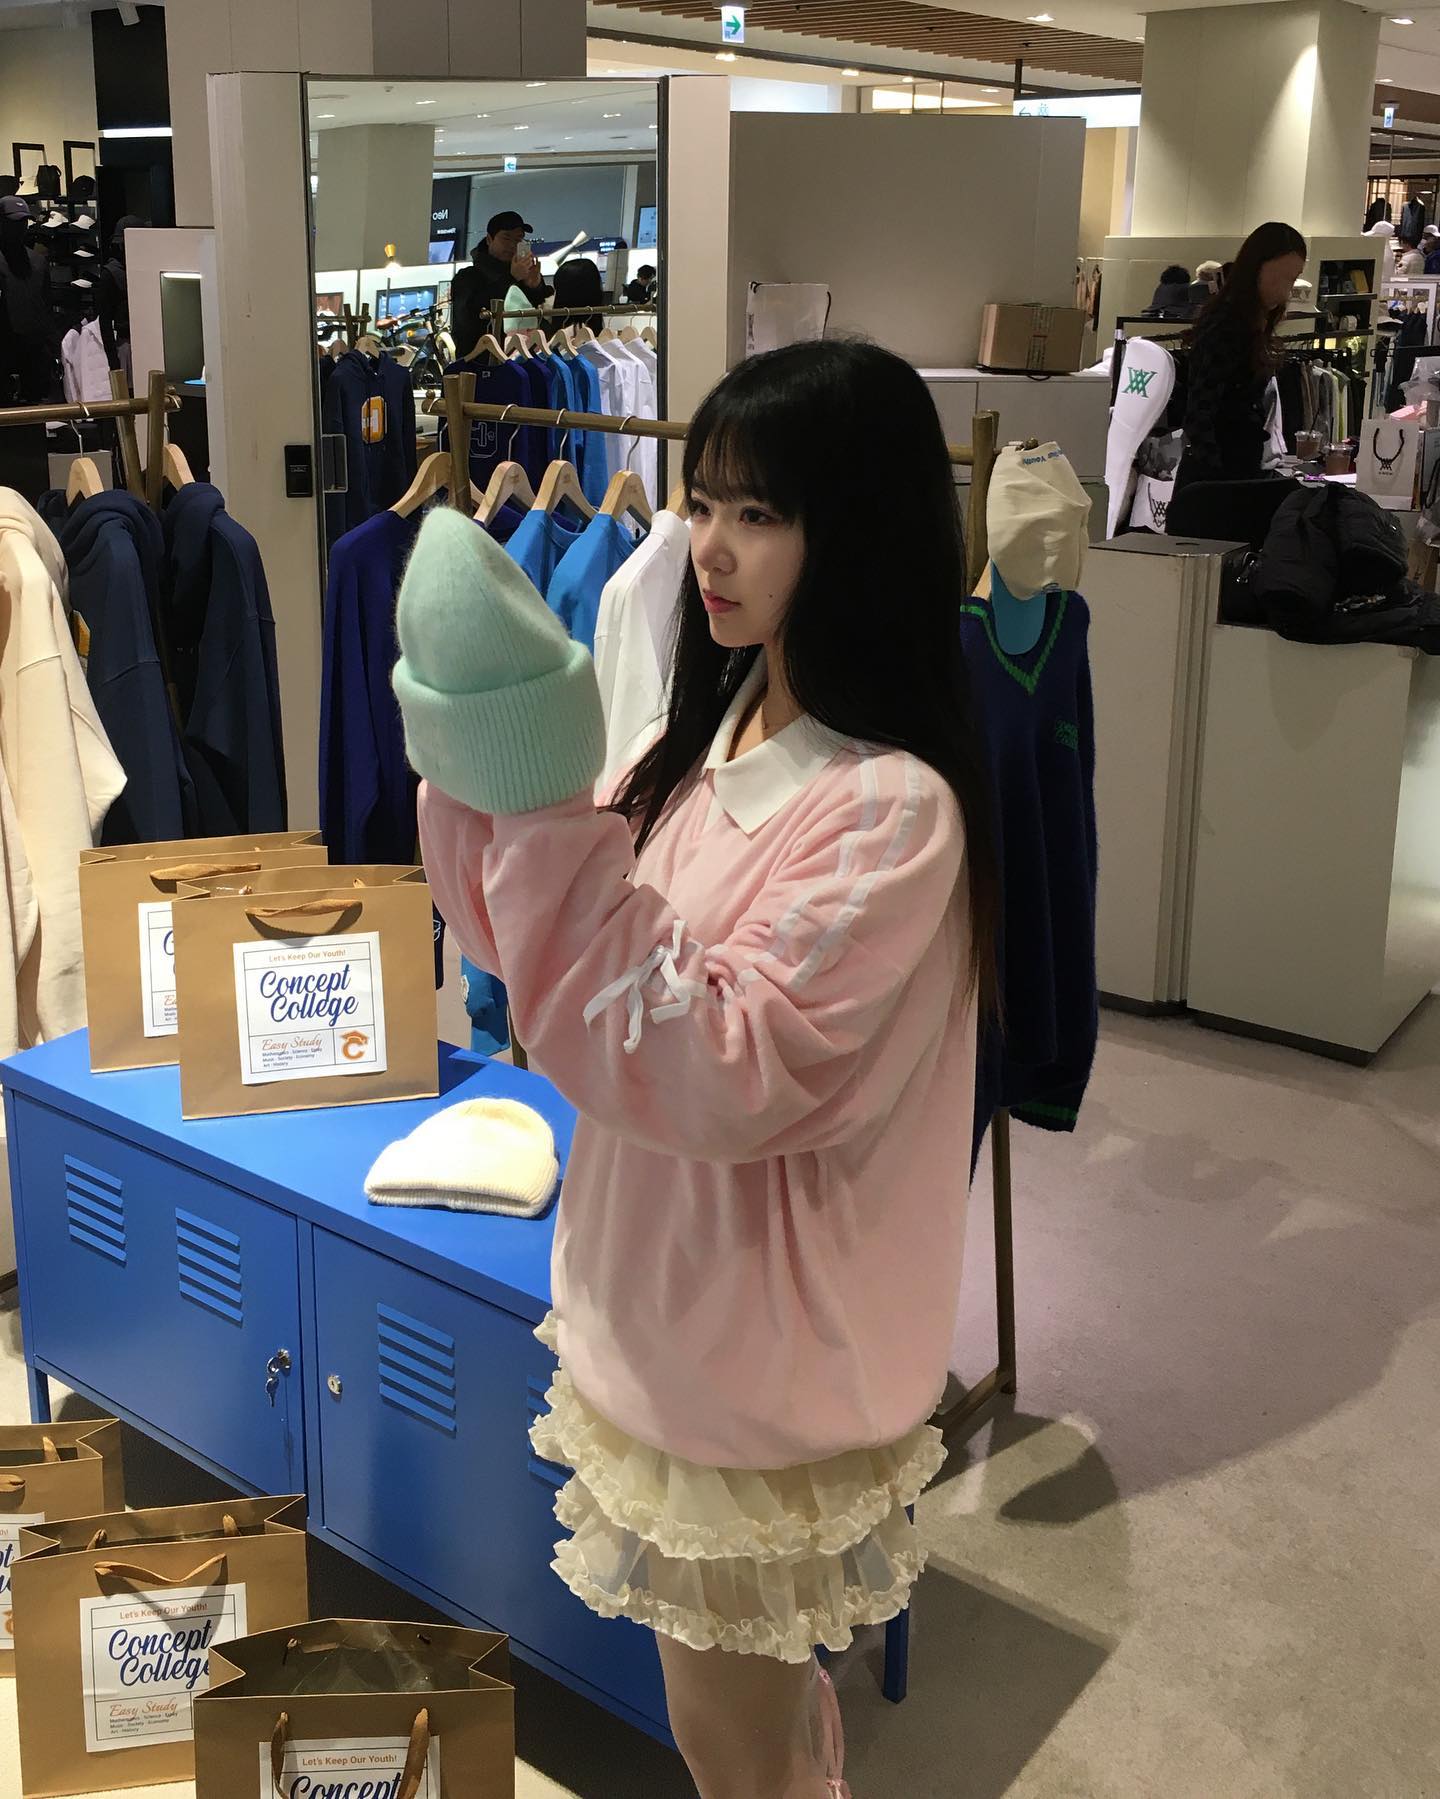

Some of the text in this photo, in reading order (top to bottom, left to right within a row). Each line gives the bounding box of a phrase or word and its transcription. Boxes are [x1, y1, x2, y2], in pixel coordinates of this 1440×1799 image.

[269, 949, 346, 962] Let's Keep Our Youth!
[260, 963, 351, 1001] Concept
[271, 992, 359, 1027] College
[262, 1033, 322, 1053] Easy Study
[120, 1603, 208, 1620] Let's Keep Our Youth!
[108, 1619, 213, 1663] Concept
[110, 1696, 178, 1718] Easy Study
[302, 1754, 398, 1767] Let's Keep Our Youth!
